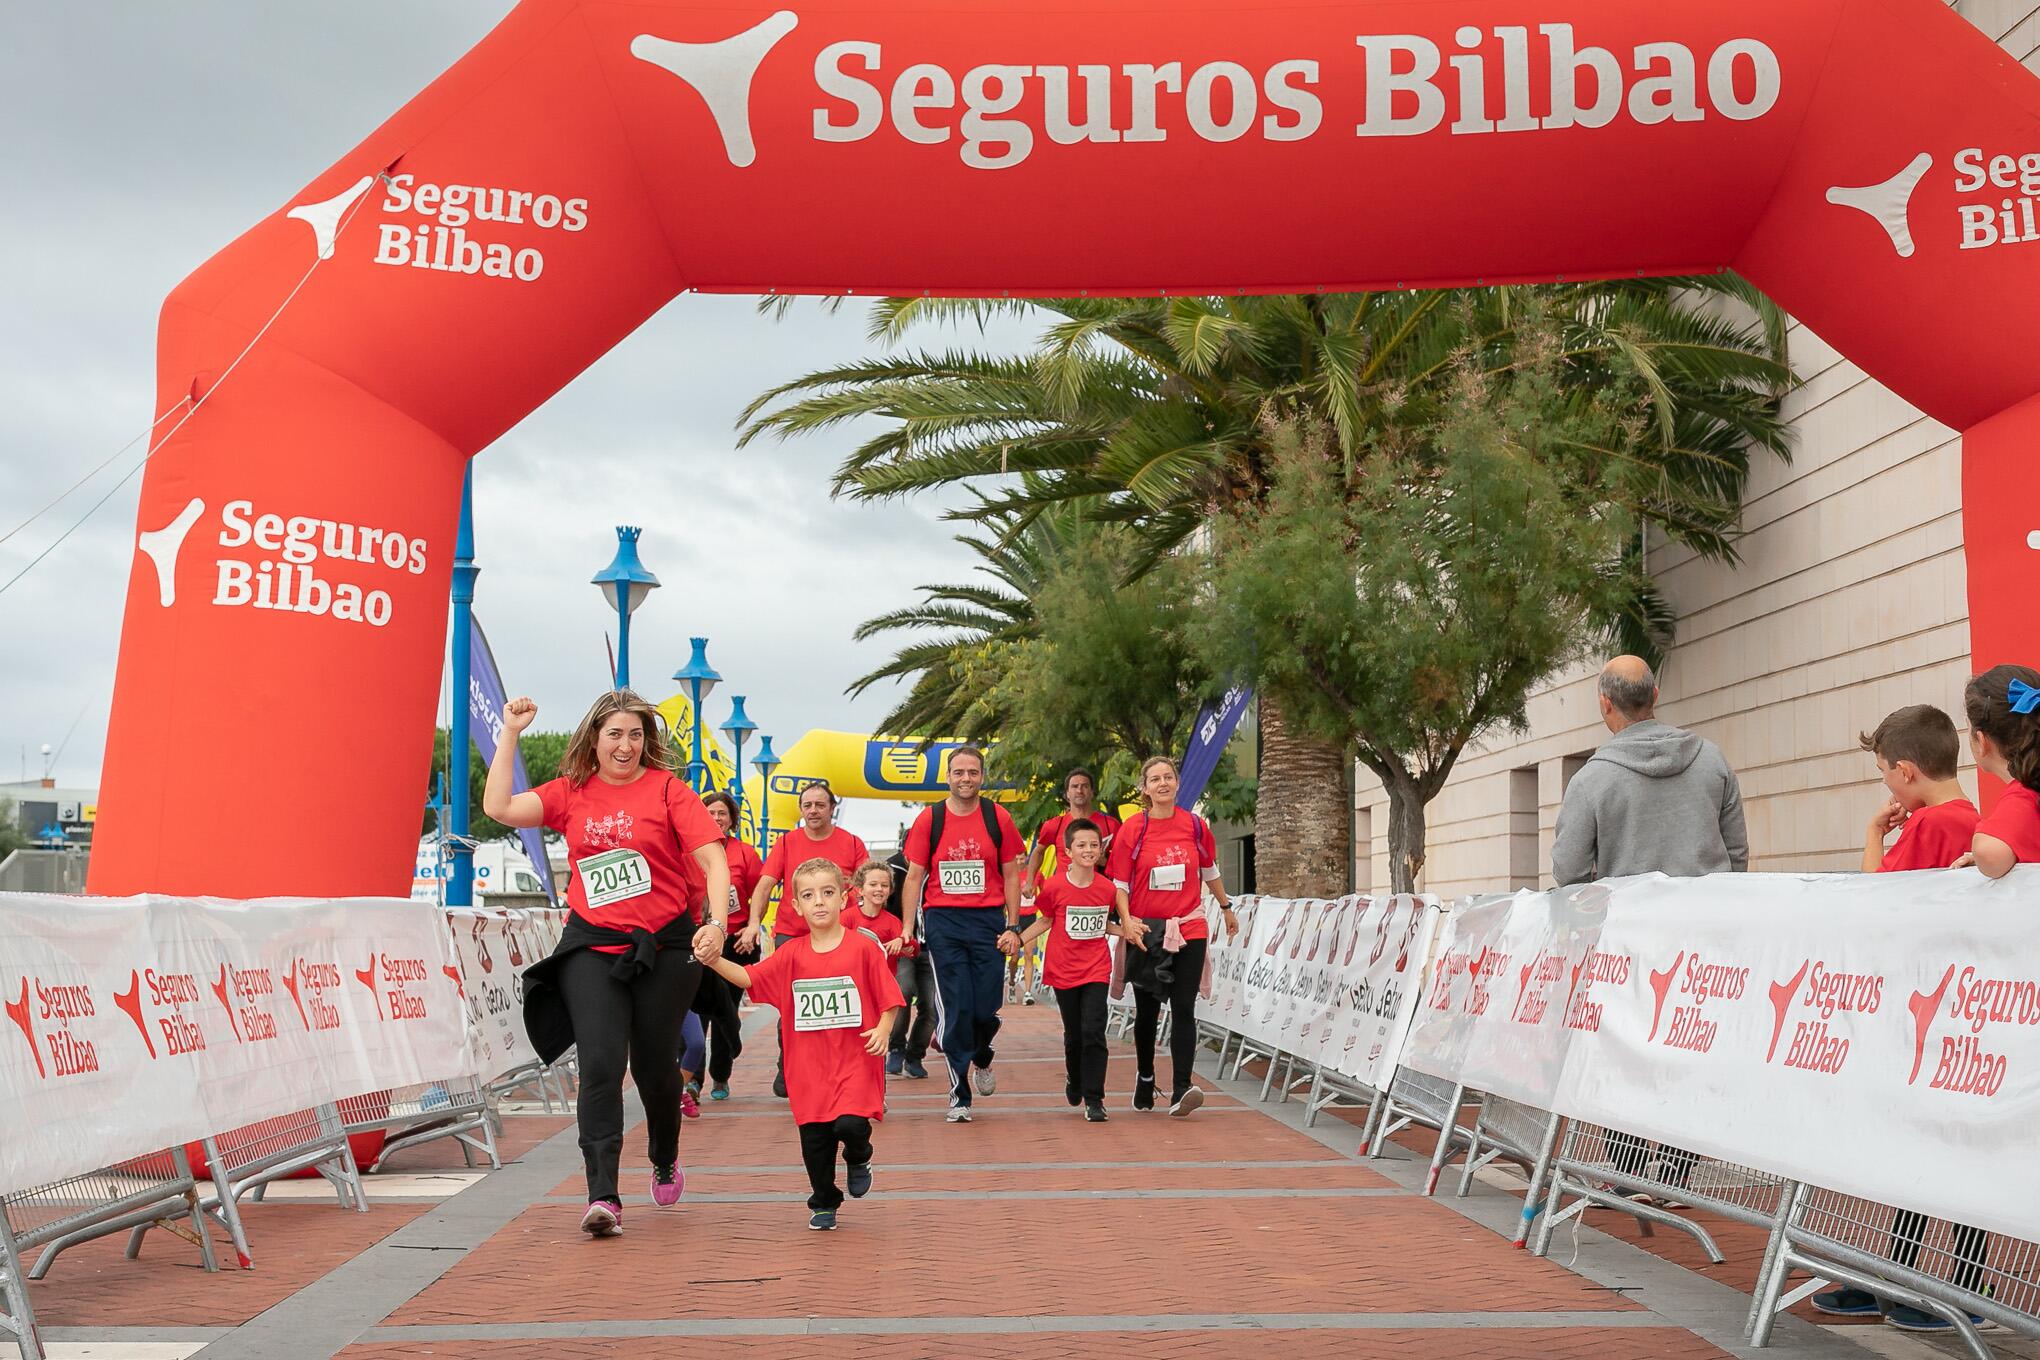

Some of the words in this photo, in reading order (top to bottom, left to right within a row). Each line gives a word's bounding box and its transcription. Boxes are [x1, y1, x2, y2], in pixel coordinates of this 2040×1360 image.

[813, 41, 1322, 169] Seguros
[1356, 23, 1780, 137] Bilbao
[383, 174, 588, 232] Seguros
[1958, 196, 2040, 250] Bil
[374, 224, 543, 281] Bilbao
[219, 500, 426, 575] Seguros
[213, 559, 392, 626] Bilbao
[590, 859, 642, 895] 2041
[945, 870, 980, 885] 2036
[1071, 915, 1104, 931] 2036
[144, 968, 198, 1011] Seguros
[228, 963, 273, 1004] Seguros
[299, 958, 341, 996] Seguros
[380, 952, 427, 988] Seguros
[1681, 952, 1749, 1005] Seguros
[1803, 960, 1884, 1020] Seguros
[35, 977, 95, 1027] Seguros
[240, 1006, 278, 1042] Bilbao
[387, 990, 427, 1020] Bilbao
[800, 991, 850, 1017] 2041
[1663, 1006, 1717, 1053] Bilbao
[1784, 1021, 1849, 1074] Bilbao
[47, 1031, 99, 1077] Bilbao
[1929, 1034, 2007, 1097] Bilbao
